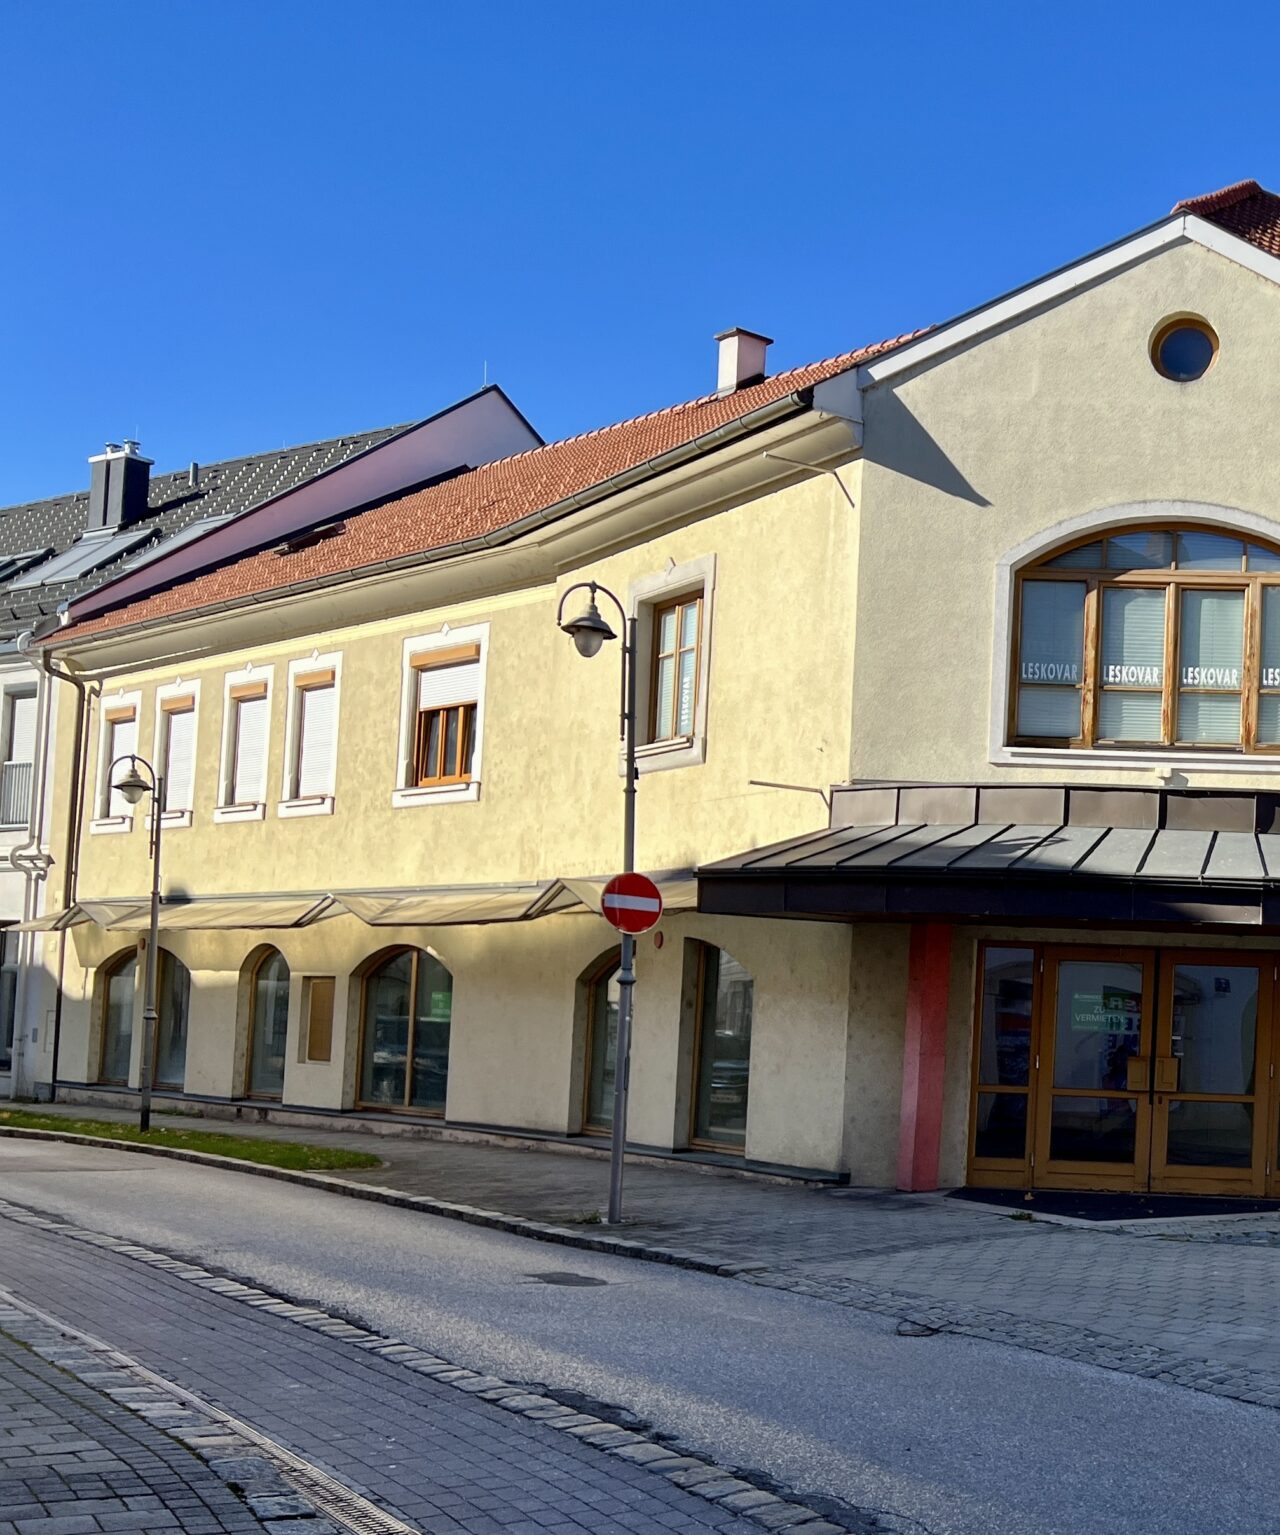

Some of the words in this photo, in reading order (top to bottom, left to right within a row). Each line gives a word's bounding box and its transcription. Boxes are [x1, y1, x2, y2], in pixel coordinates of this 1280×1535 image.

[1022, 663, 1078, 680] LESKOVAR
[1103, 665, 1159, 683] LESKOVAR
[1182, 666, 1238, 686] LESKOVAR
[1075, 1014, 1124, 1022] VERMIETEN
